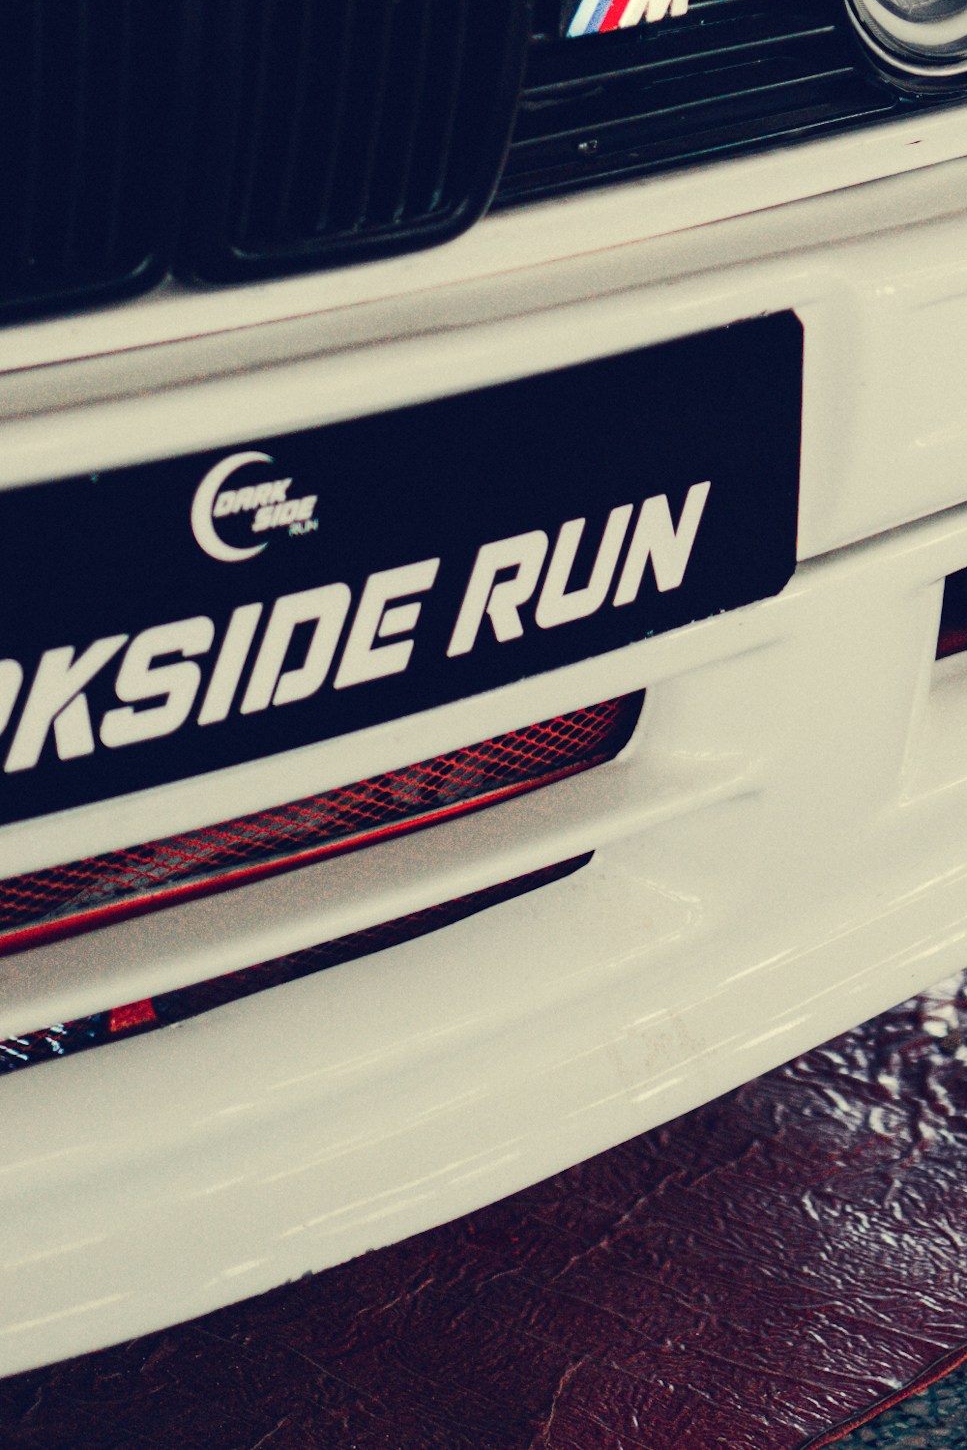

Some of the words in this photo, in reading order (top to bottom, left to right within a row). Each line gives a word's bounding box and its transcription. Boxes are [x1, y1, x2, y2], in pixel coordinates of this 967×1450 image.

[213, 477, 293, 518] DARK
[251, 494, 318, 533] SIDE
[0, 558, 440, 772] KSIDE
[447, 480, 710, 658] RUN
